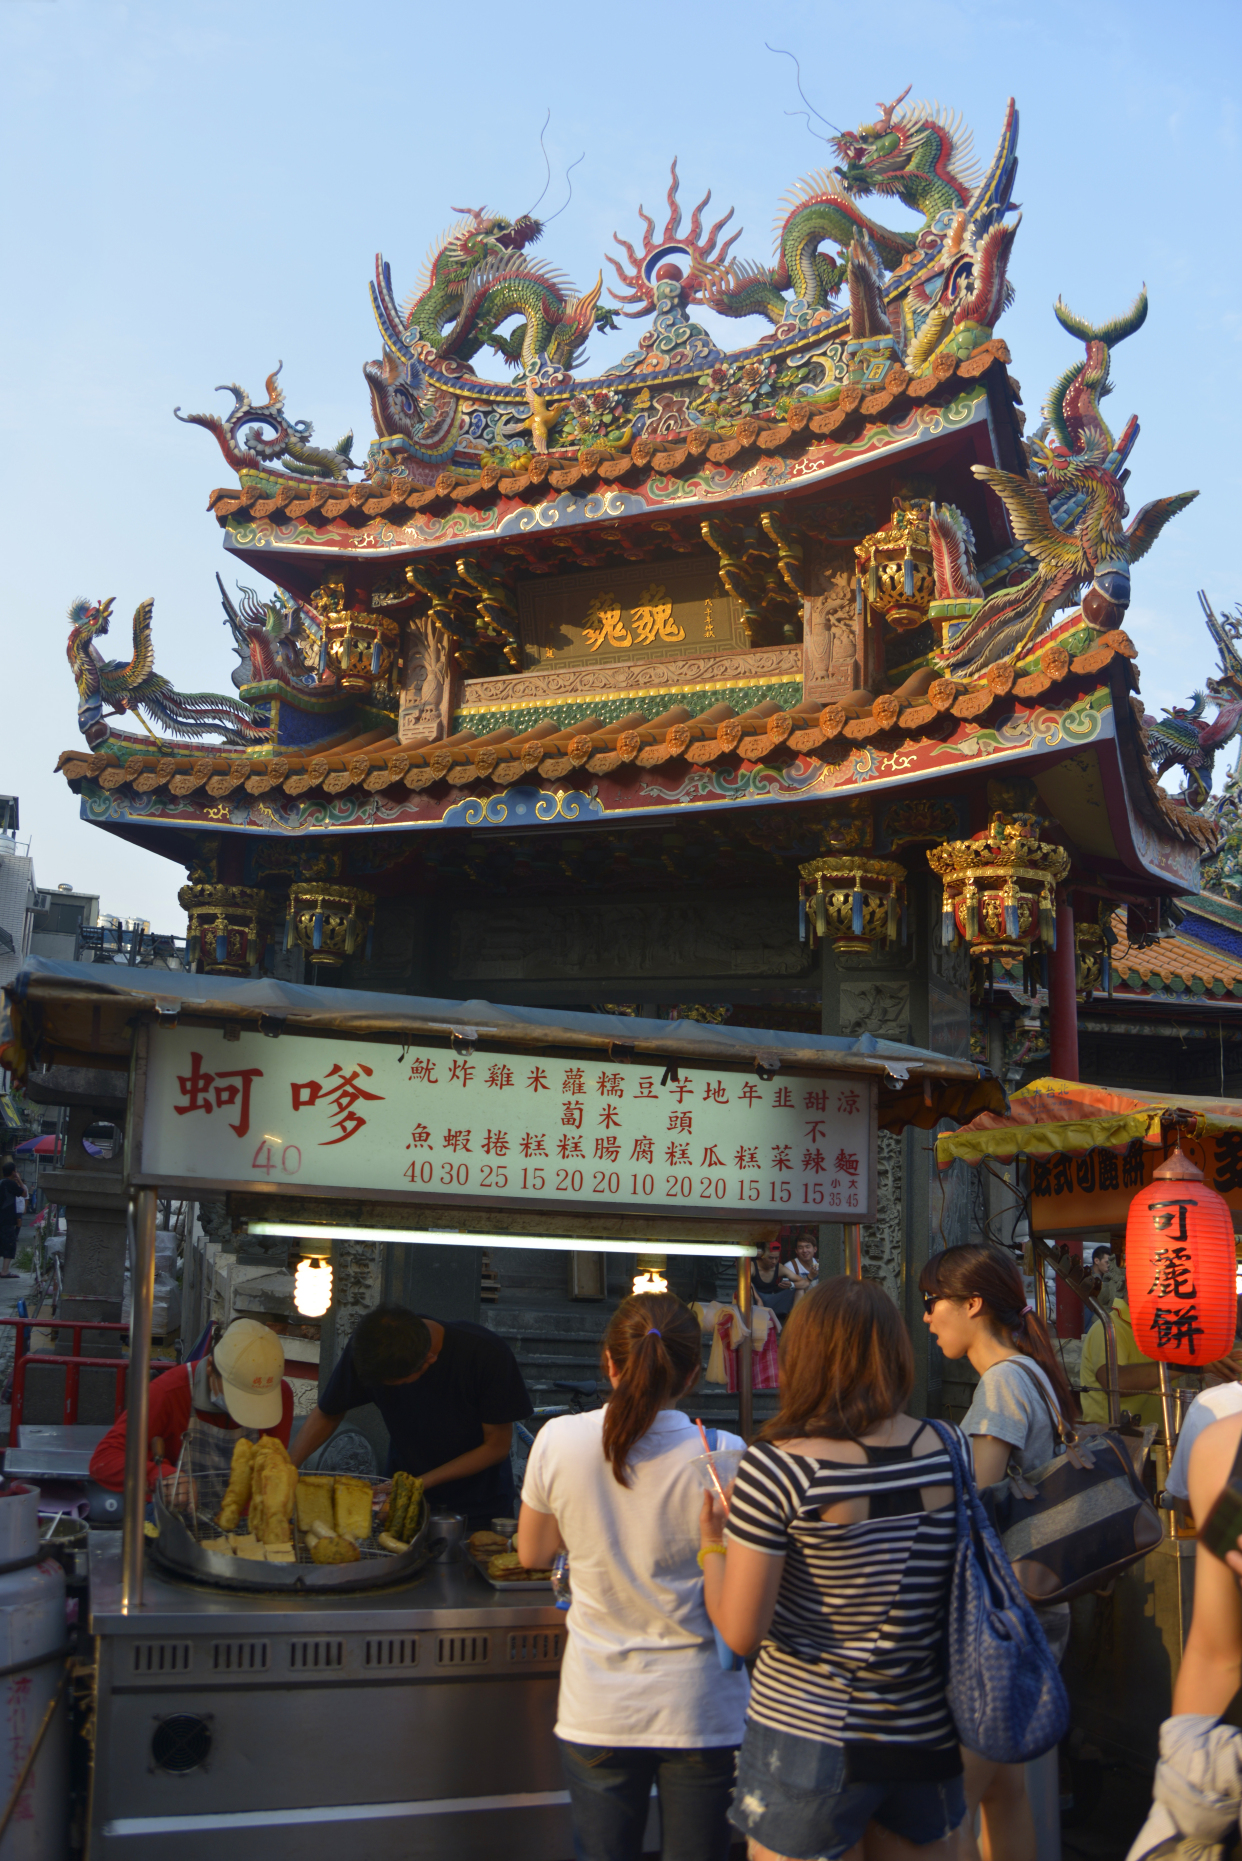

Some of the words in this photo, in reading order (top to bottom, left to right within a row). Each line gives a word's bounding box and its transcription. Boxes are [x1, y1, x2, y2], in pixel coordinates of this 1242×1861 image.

[174, 1052, 385, 1148] 蚵嗲
[406, 1058, 438, 1150] 魷魚
[443, 1060, 475, 1152] 炸蝦
[481, 1064, 514, 1156] 雞捲
[520, 1066, 550, 1158] 米糕
[557, 1068, 586, 1159] 蘿蔔糕
[594, 1071, 624, 1162] 糯米腸
[630, 1076, 658, 1164] 豆腐
[665, 1077, 694, 1166] 芋頭糕
[701, 1080, 729, 1167] 地瓜
[735, 1081, 762, 1169] 年糕
[772, 1087, 794, 1171] 韭菜
[802, 1090, 829, 1174] 甜不辣
[835, 1090, 861, 1176] 涼麵
[252, 1139, 301, 1175] 40
[404, 1161, 432, 1183] 40
[441, 1162, 468, 1185] 30
[480, 1165, 508, 1187] 25
[522, 1168, 545, 1190] 15
[556, 1169, 583, 1191] 20
[593, 1171, 619, 1193] 20
[632, 1174, 654, 1195] 10
[666, 1176, 692, 1197] 20
[700, 1177, 726, 1199] 20
[739, 1180, 760, 1201] 15
[771, 1182, 791, 1202] 15
[803, 1183, 824, 1204] 15
[829, 1192, 841, 1206] 35
[846, 1193, 858, 1207] 45
[831, 1179, 841, 1188] 小
[848, 1179, 858, 1189] 大
[1147, 1199, 1204, 1355] 可麗餅
